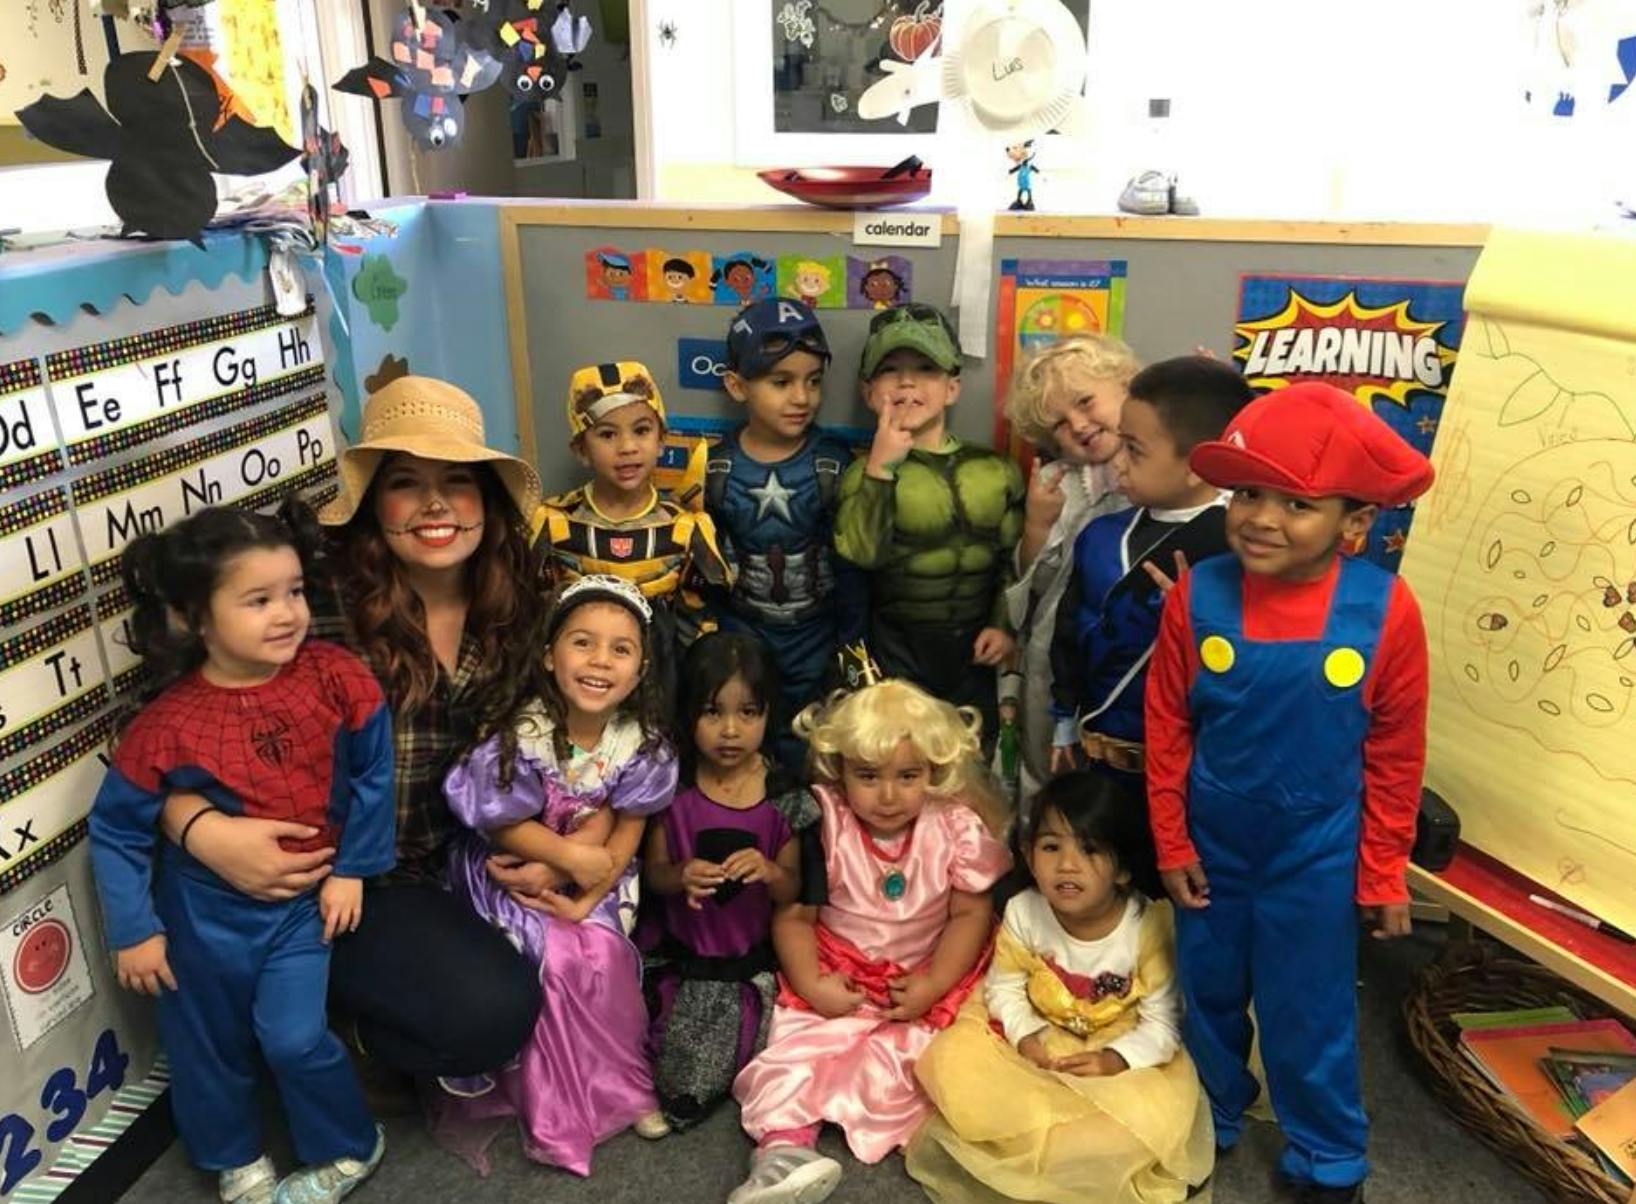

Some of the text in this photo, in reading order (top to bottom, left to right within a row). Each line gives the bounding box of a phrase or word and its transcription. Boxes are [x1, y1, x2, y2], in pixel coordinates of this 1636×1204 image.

[865, 220, 931, 236] calendar
[778, 302, 804, 323] A
[75, 382, 121, 430] Ee
[154, 359, 182, 407] Ff
[213, 347, 257, 386] Gg
[278, 327, 311, 369] Hh
[691, 356, 728, 376] Oc
[1244, 327, 1442, 388] LEARNING
[25, 428, 323, 582] Ll Mm Nn Oo Pp
[45, 650, 82, 696] Tt
